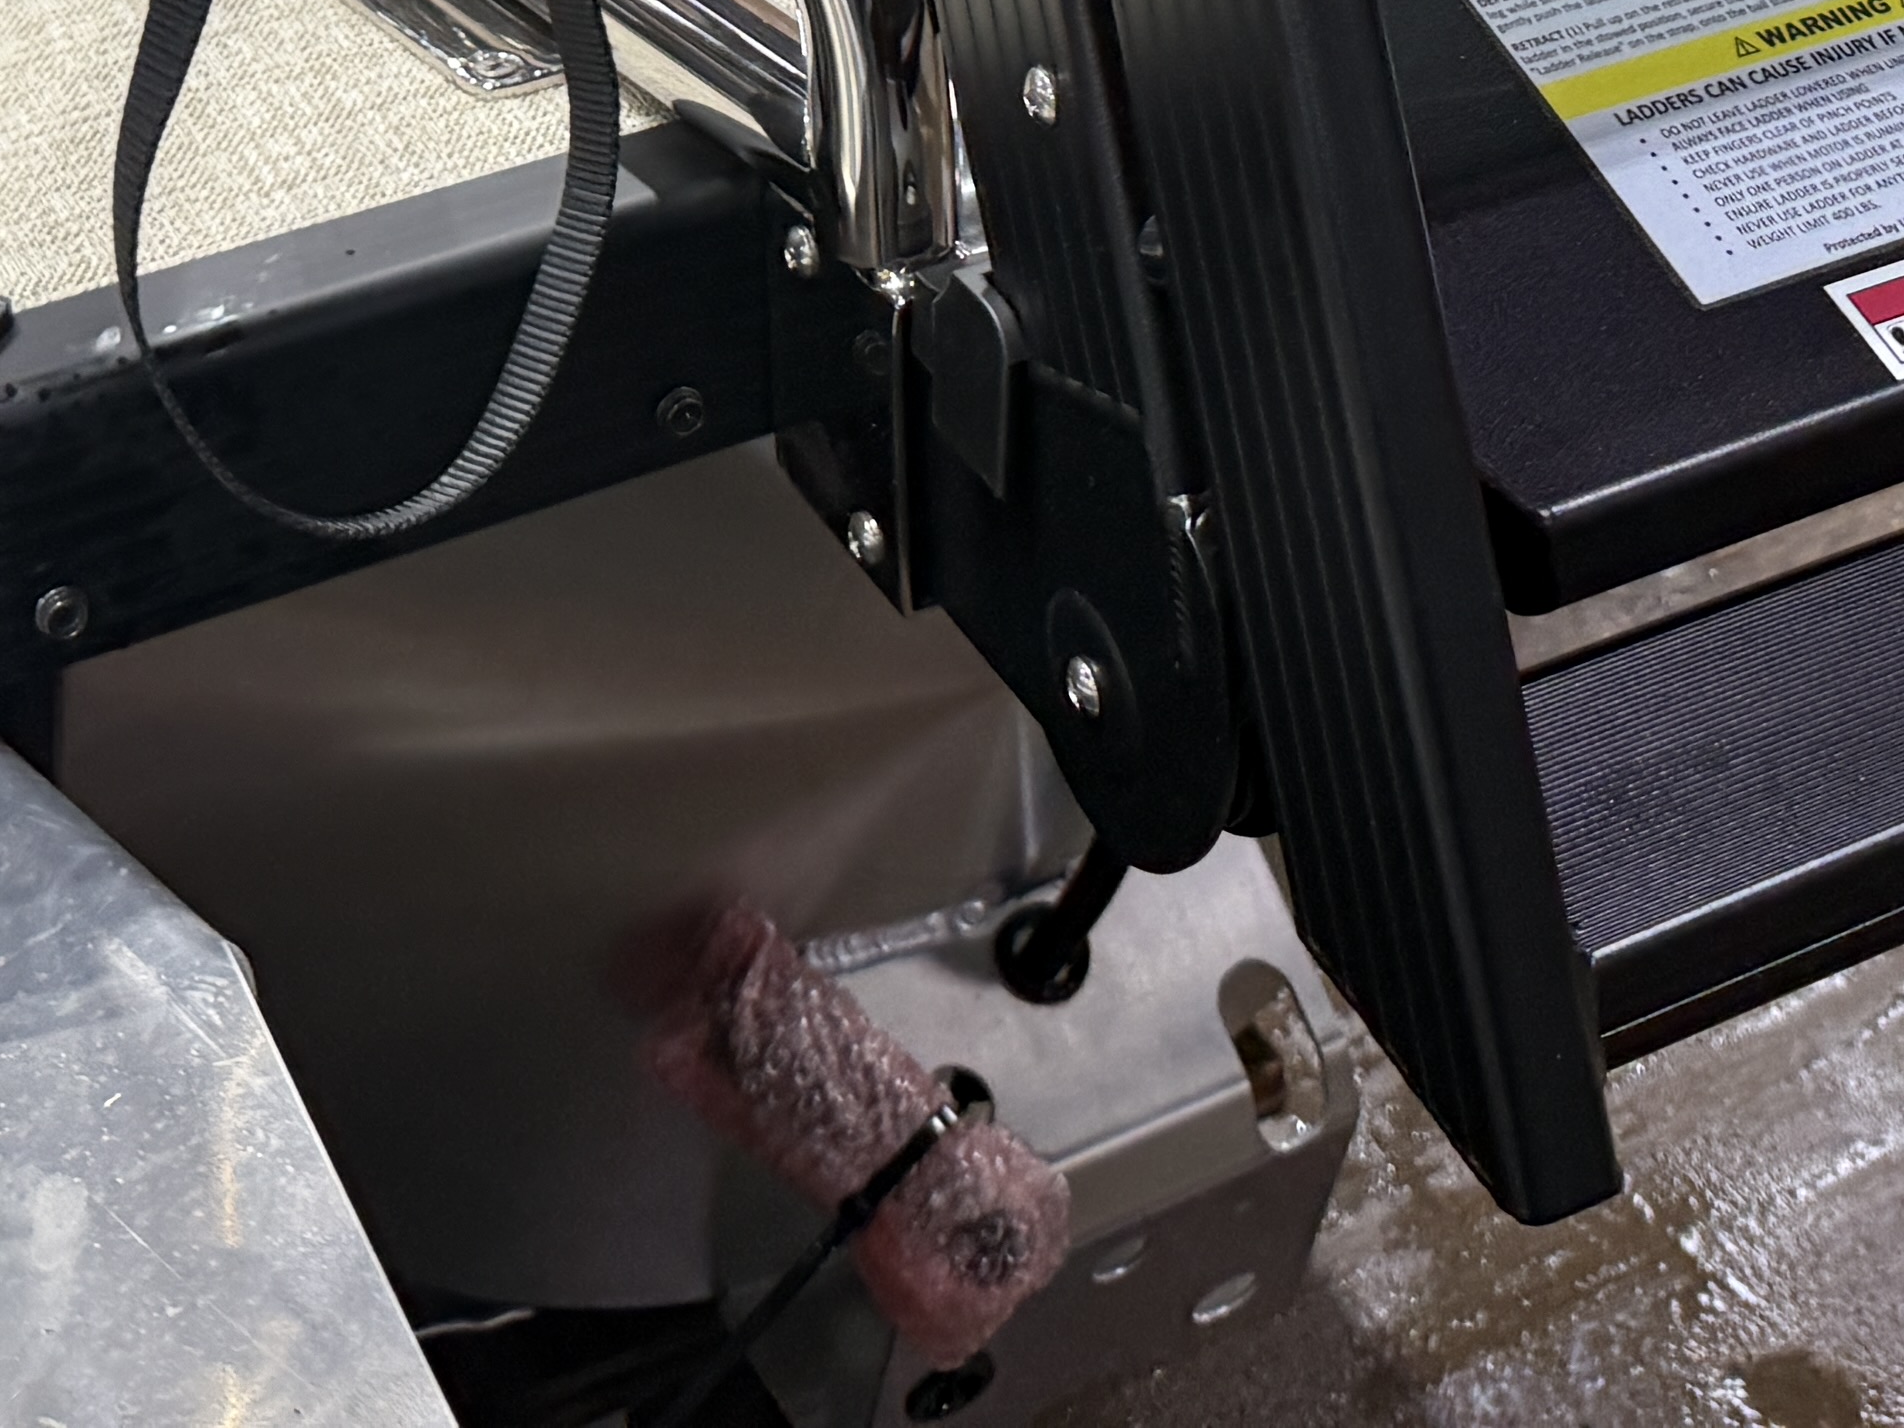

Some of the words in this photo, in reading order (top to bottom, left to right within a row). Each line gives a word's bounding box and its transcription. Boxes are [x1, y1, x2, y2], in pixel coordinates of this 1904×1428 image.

[1510, 29, 1566, 52] RETRACT
[1563, 23, 1586, 39] (1)
[1613, 88, 1704, 127] LADDERS
[1703, 74, 1749, 99] CAN
[1747, 55, 1812, 85] CAUSE
[1809, 34, 1878, 67] INJURY
[1876, 27, 1897, 46] IF
[1659, 124, 1682, 139] DO
[1679, 115, 1707, 132] NOT
[1706, 104, 1746, 125] LEAVE
[1743, 90, 1792, 113] LADDER
[1789, 73, 1848, 99] LOWERED
[1844, 61, 1886, 81] WHEN
[1670, 129, 1719, 152] ALWAYS
[1716, 119, 1749, 137] FACE
[1745, 105, 1795, 128] LADDER
[1792, 93, 1834, 113] WHEN
[1829, 81, 1871, 102] USING
[1680, 148, 1711, 166] KEEP
[1711, 132, 1764, 156] FINGERS
[1761, 120, 1801, 141] CLEAR
[1798, 114, 1816, 129] OF
[1815, 105, 1855, 123] PINCH
[1852, 90, 1898, 111] POINTS
[1691, 159, 1733, 179] CHECK
[1731, 137, 1801, 166] HARDWARE
[1800, 129, 1828, 145] AND
[1826, 113, 1875, 137] LADDER
[1702, 172, 1745, 193] NEVER
[1742, 164, 1770, 181] USE
[1767, 152, 1809, 172] WHEN
[1805, 137, 1854, 160] MOTOR
[1850, 133, 1866, 146] IS
[1713, 188, 1746, 208] ONLY
[1745, 180, 1776, 197] ONE
[1773, 164, 1823, 188] PERSON
[1820, 158, 1844, 173] ON
[1841, 143, 1890, 167] LADDER
[1888, 137, 1904, 151] AT
[1723, 197, 1774, 222] ENSURE
[1771, 182, 1822, 206] LADDER
[1819, 177, 1835, 191] IS
[1832, 160, 1890, 186] PROPERLY
[1735, 214, 1779, 235] NEVER
[1775, 205, 1803, 222] USE
[1801, 190, 1850, 215] LADDER
[1847, 182, 1876, 198] FOR
[1745, 225, 1797, 249] WEIGHT
[1795, 213, 1831, 234] LIMIT
[1831, 206, 1856, 221] 400
[1822, 225, 1883, 254] Protected
